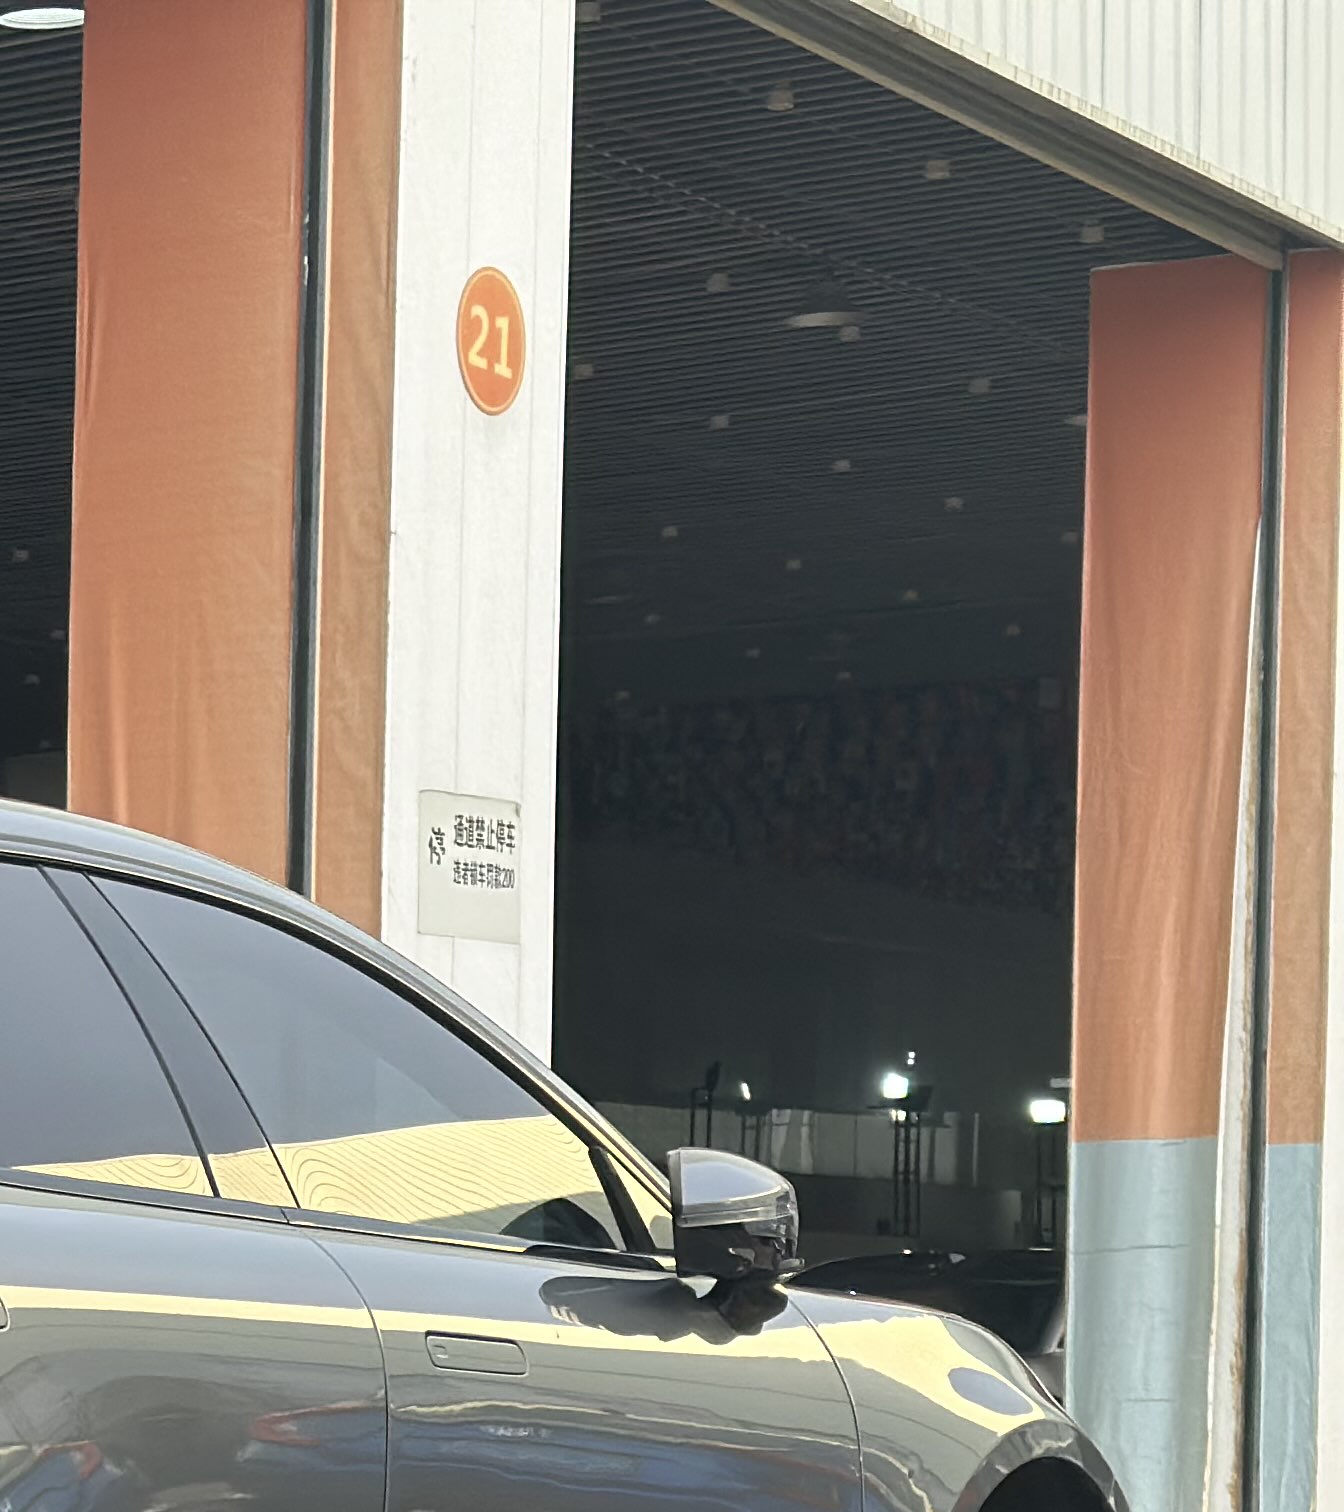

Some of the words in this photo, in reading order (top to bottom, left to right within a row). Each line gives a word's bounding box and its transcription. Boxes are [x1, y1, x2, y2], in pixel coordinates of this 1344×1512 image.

[468, 304, 513, 380] 21
[454, 814, 516, 854] 通道禁止停车
